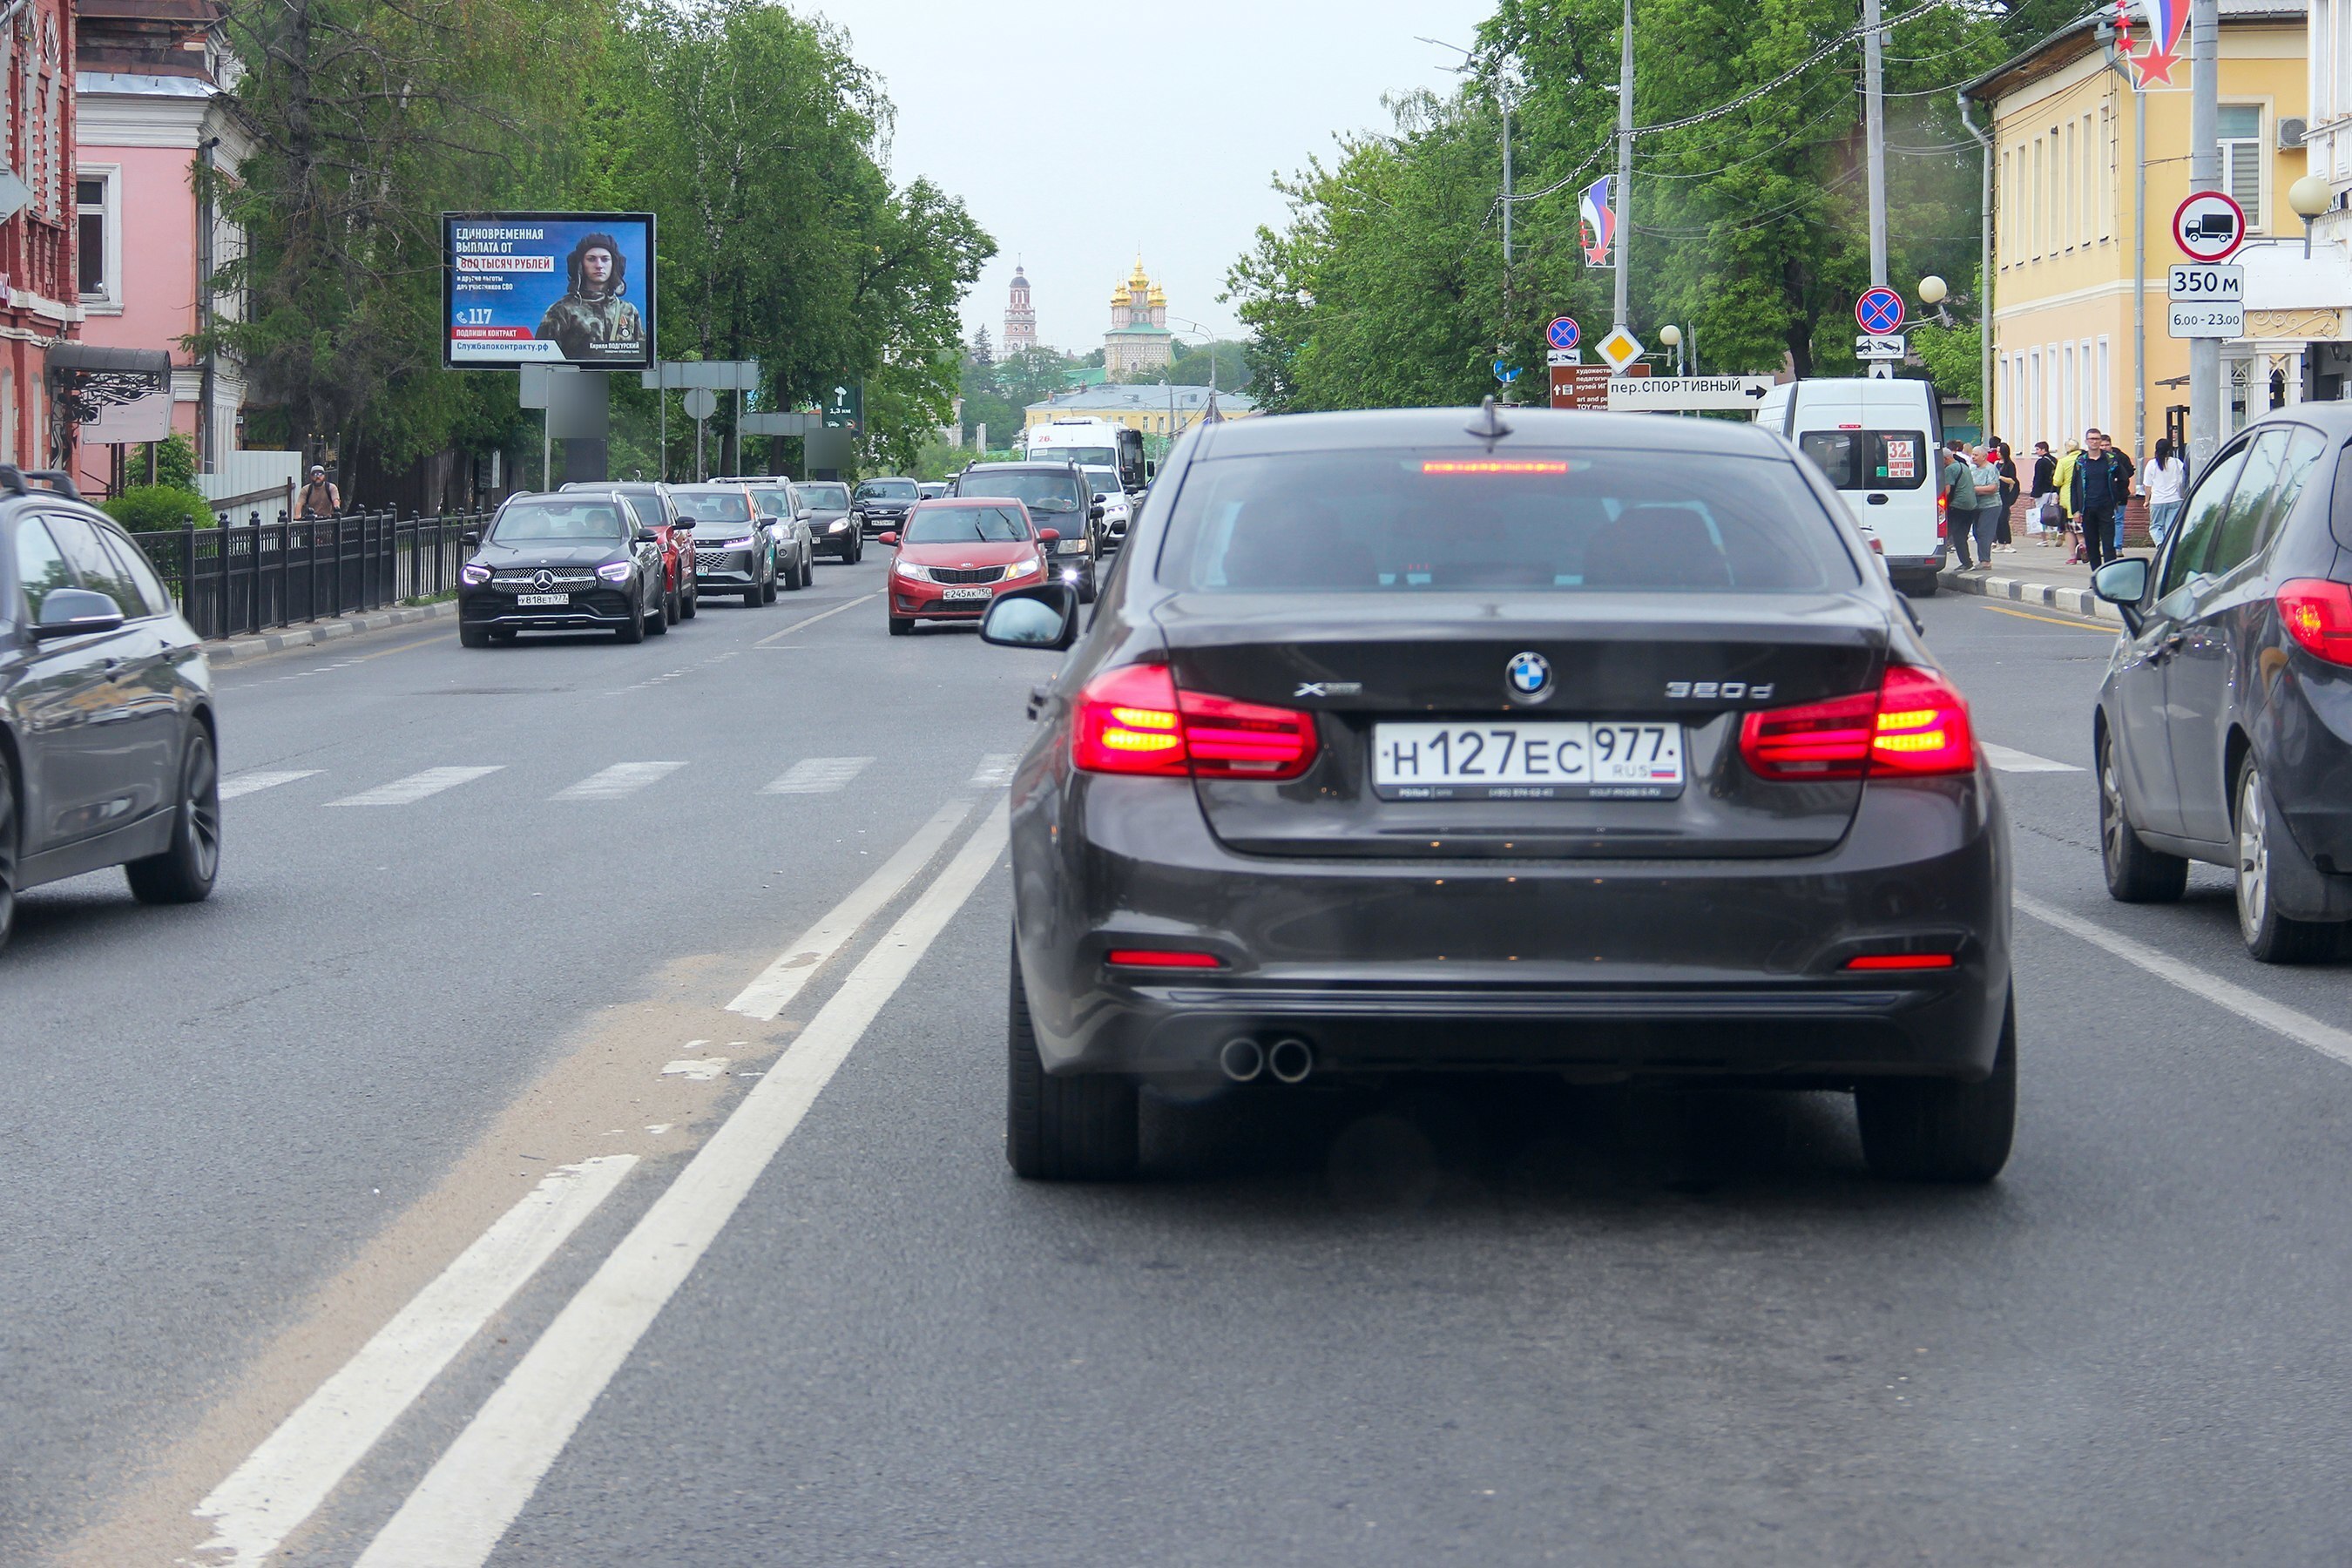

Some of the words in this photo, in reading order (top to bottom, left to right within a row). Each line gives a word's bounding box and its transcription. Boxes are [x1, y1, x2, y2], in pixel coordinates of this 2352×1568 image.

[456, 228, 544, 240] ЕДИНОВРЕМЕННАЯ
[456, 242, 499, 253] ВЫПЛАТА
[501, 242, 513, 253] ОТ
[460, 259, 479, 268] 800
[481, 259, 512, 268] ТЫСЯЧ
[515, 256, 551, 268] РУБЛЕЙ
[2173, 272, 2218, 292] 350
[469, 308, 493, 324] 117
[2173, 314, 2198, 326] 6.00
[2207, 314, 2240, 325] 23.00
[456, 329, 487, 338] ПОДПИШИ
[456, 342, 549, 352] Службапоконтракту.рф
[1665, 682, 1775, 699] 320d
[1594, 727, 1666, 762] 977
[1612, 765, 1648, 778] RUS
